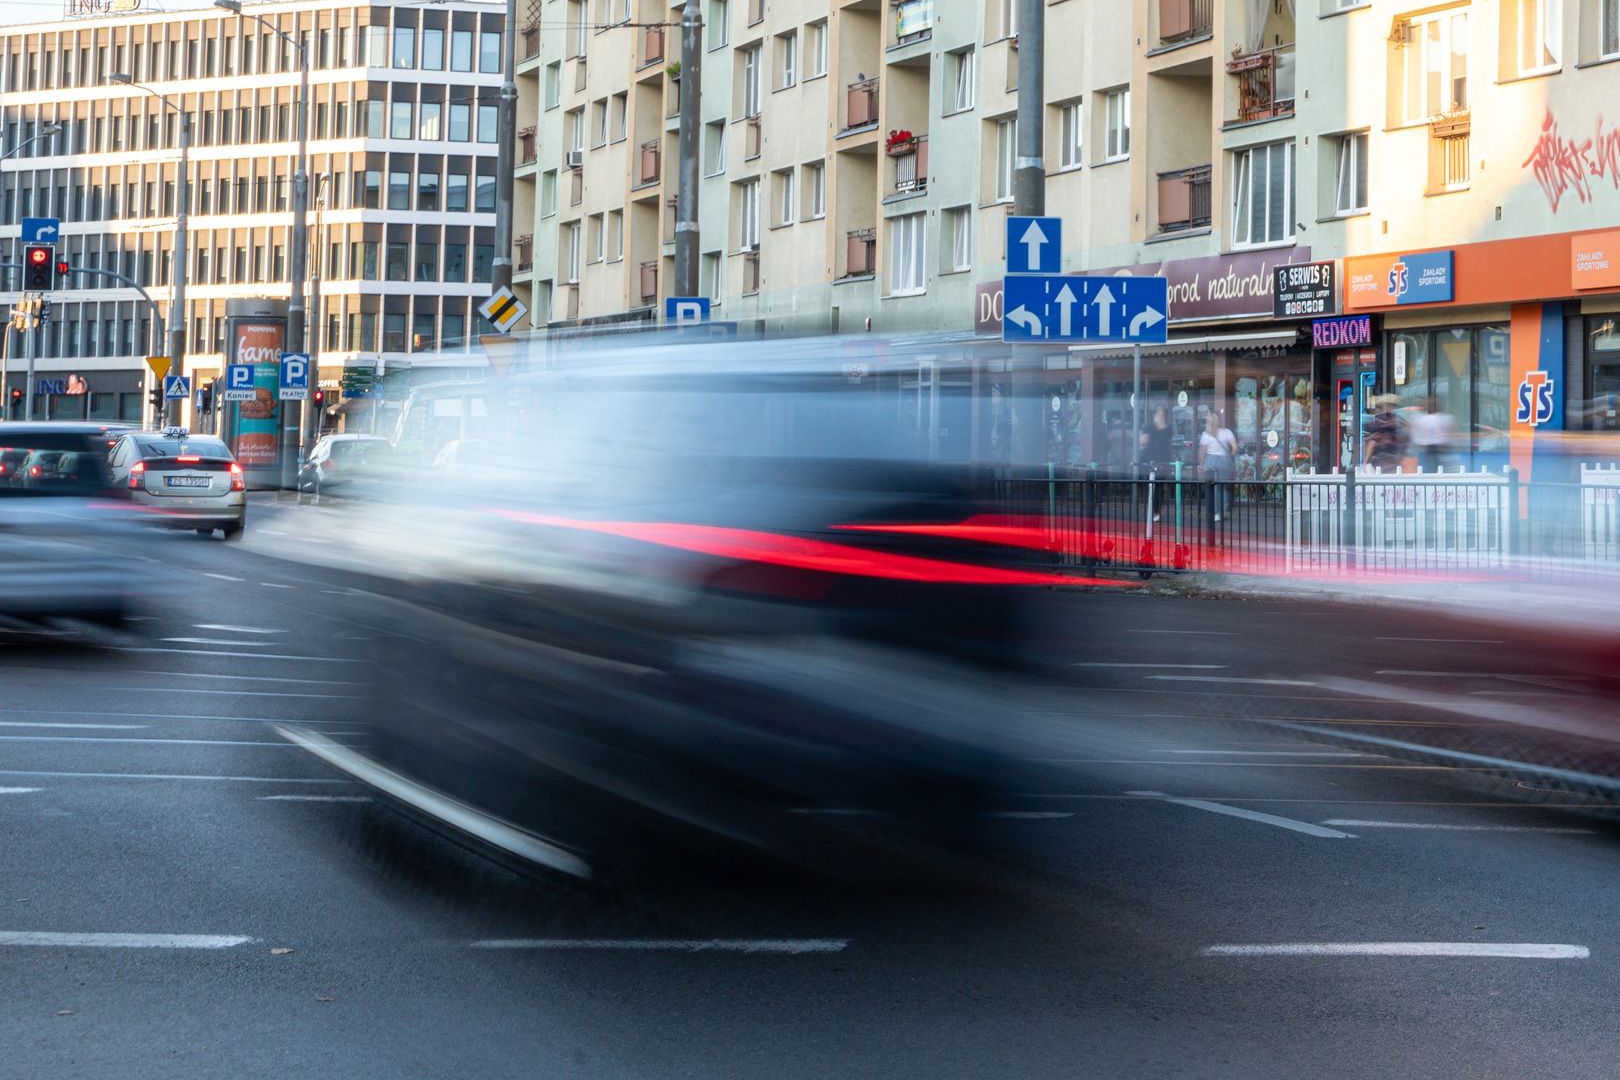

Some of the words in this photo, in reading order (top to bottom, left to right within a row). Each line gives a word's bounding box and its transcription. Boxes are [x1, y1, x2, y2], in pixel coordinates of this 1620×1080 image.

[1576, 251, 1604, 263] ZAKŁADY
[1422, 267, 1447, 277] ZAKŁADY
[1576, 260, 1609, 272] SPORTOWE
[1289, 265, 1320, 286] SERWIS
[1387, 262, 1409, 297] STS
[1418, 276, 1447, 287] SPORTOWE
[1312, 319, 1370, 347] REDKOM
[37, 379, 65, 395] ING
[227, 391, 254, 399] Koniec
[1516, 370, 1554, 427] STS
